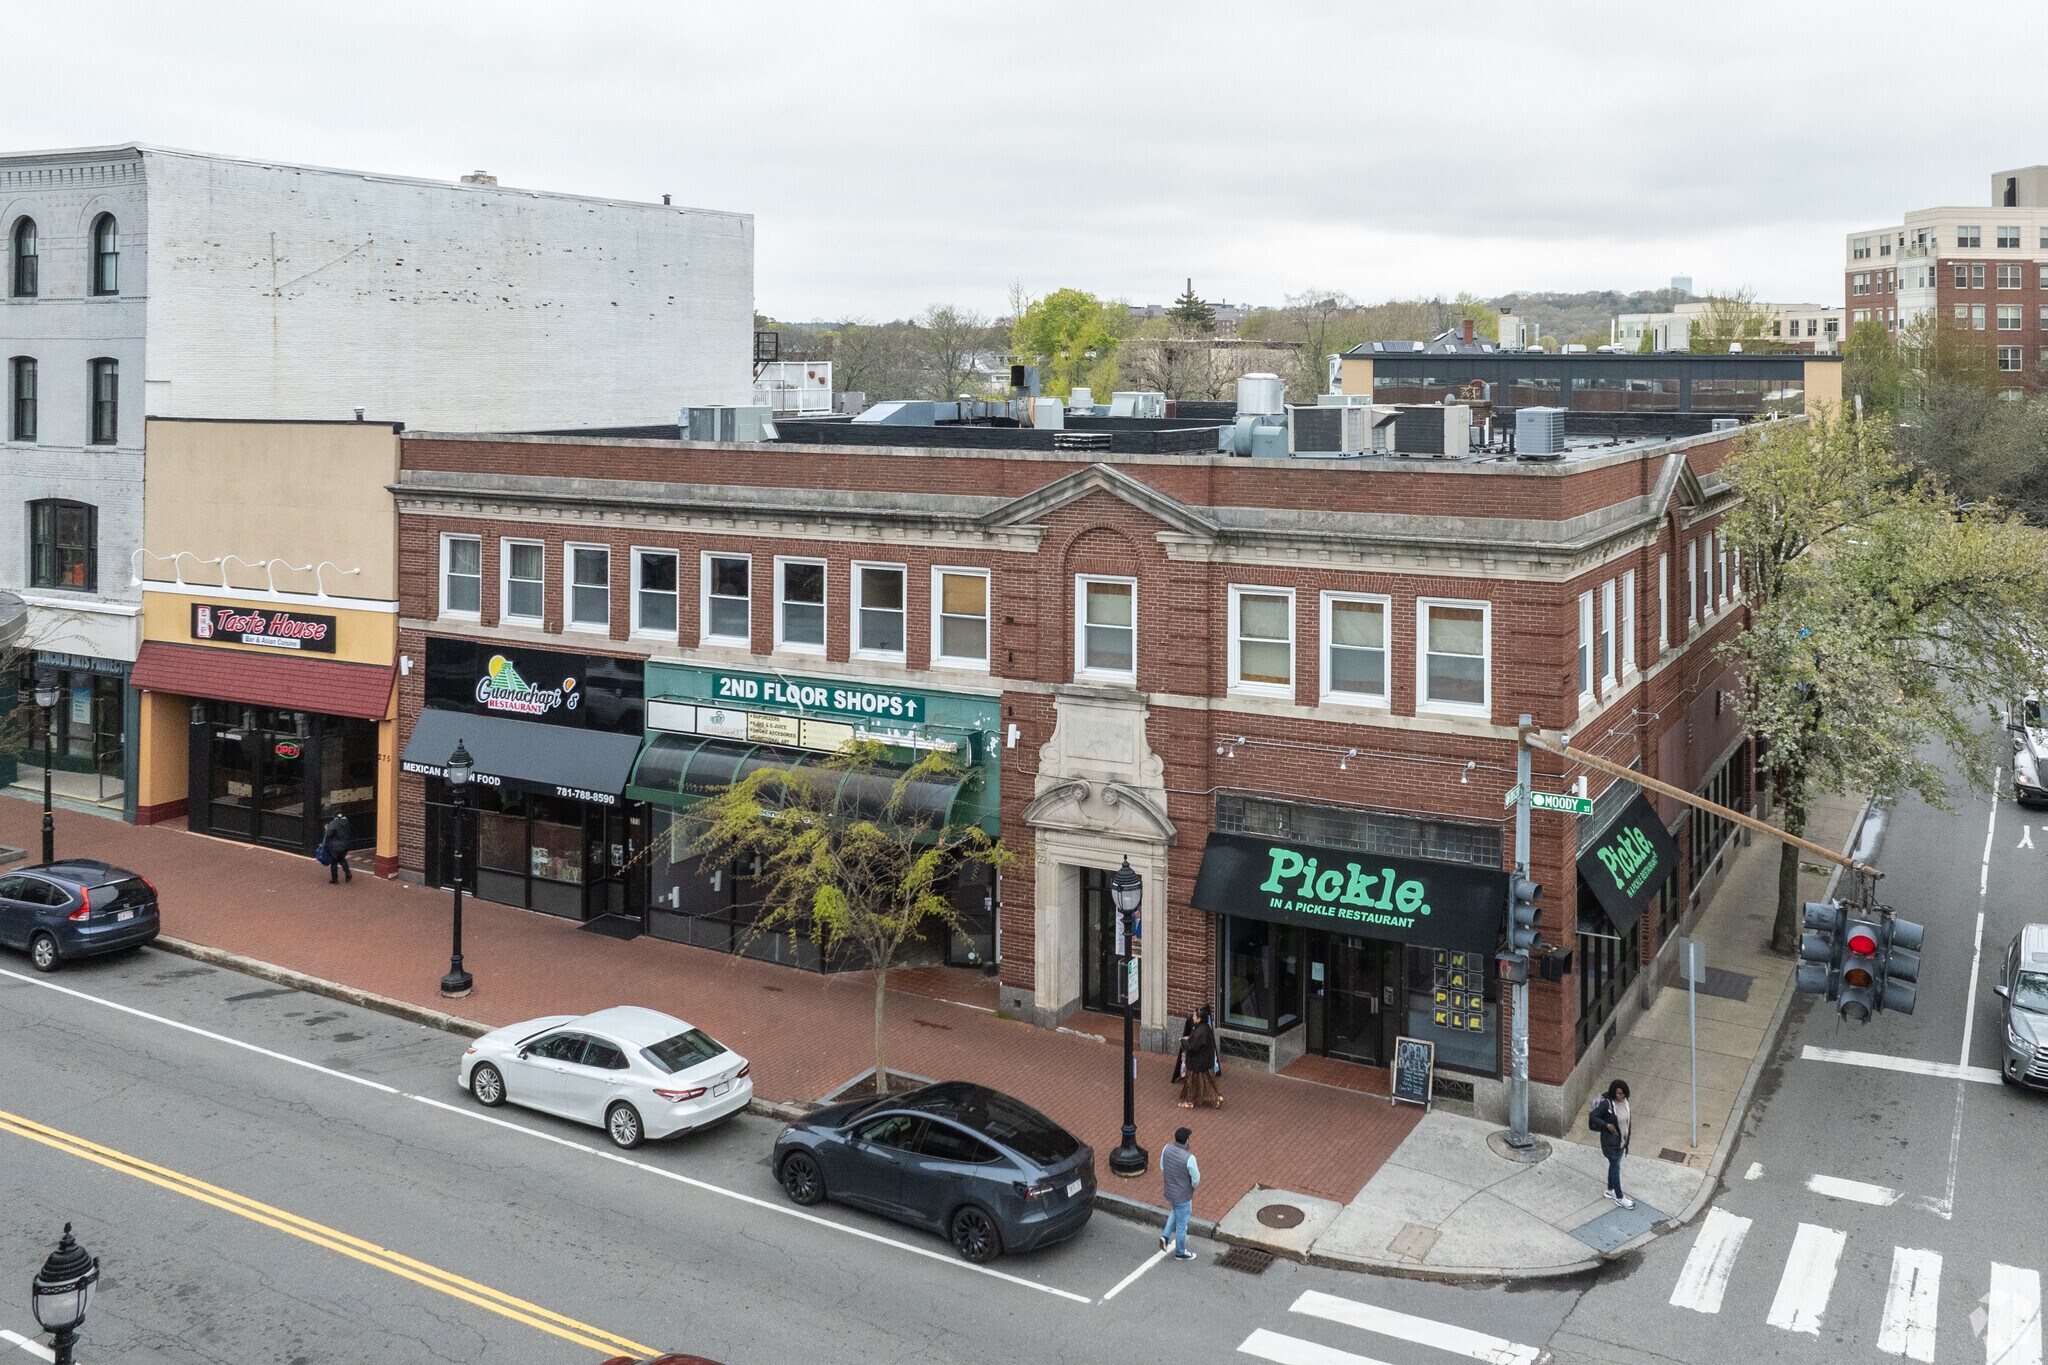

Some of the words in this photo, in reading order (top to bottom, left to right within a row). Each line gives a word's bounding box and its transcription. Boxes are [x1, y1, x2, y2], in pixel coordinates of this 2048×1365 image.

[217, 609, 266, 634] Taste
[268, 613, 327, 641] House
[261, 637, 276, 645] Asian
[277, 638, 298, 647] Cuisine
[91, 658, 124, 674] PROJECT
[489, 699, 542, 713] RESTAURANT
[719, 677, 758, 698] 2ND
[763, 682, 829, 708] FLOOR
[833, 690, 903, 716] SHOPS
[275, 744, 300, 756] OPEN
[378, 754, 391, 762] 275
[403, 762, 441, 776] MEXICAN
[443, 769, 449, 778] &
[477, 773, 501, 786] FOOD
[556, 786, 615, 804] 781-788-8590
[1544, 795, 1579, 811] MOODY
[1583, 805, 1590, 813] ST
[1597, 826, 1654, 890] Pickle.
[1260, 847, 1431, 916] Pickle.
[1270, 898, 1283, 909] IN
[1284, 901, 1293, 910] A
[1295, 902, 1336, 917] PICKLE
[1338, 908, 1416, 928] RESTAURANT
[1400, 1042, 1428, 1062] OPEN
